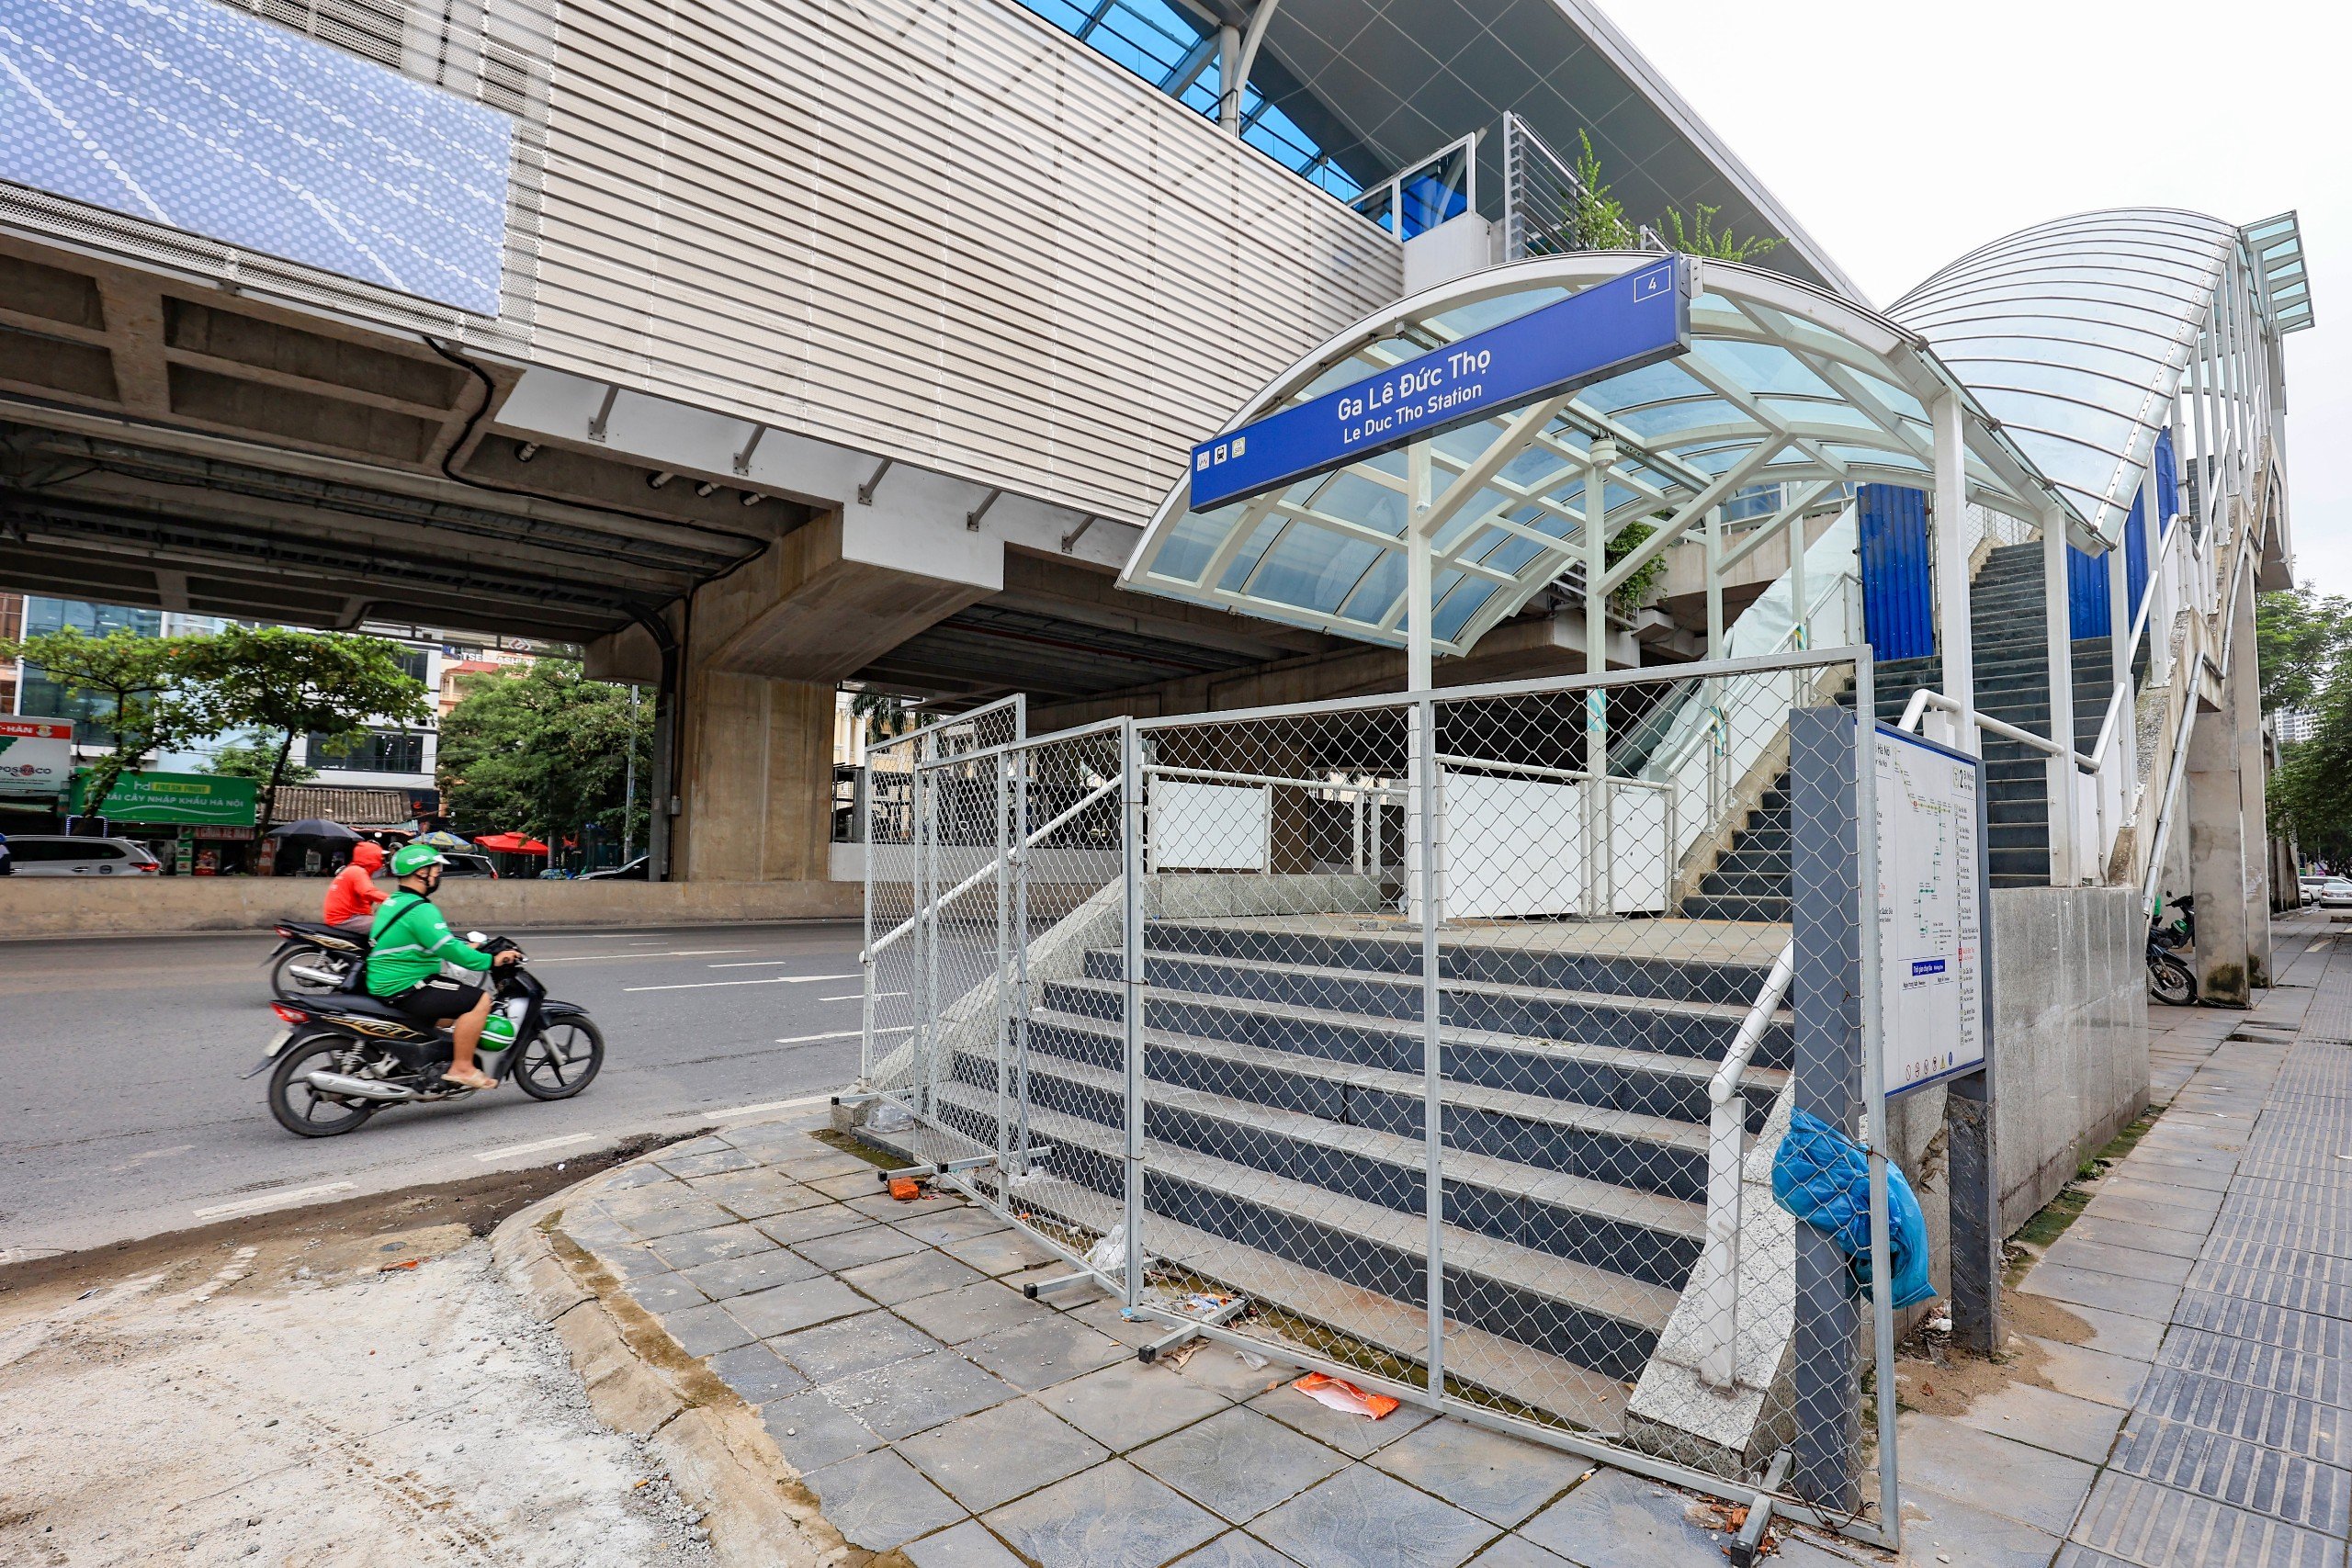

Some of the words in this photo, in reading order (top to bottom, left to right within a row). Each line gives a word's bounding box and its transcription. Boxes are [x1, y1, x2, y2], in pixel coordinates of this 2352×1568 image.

[1648, 277, 1657, 290] 4
[1338, 399, 1363, 421] Ga
[1369, 381, 1395, 411] Lê
[1399, 367, 1442, 399] Đức
[1448, 350, 1491, 378] Thọ
[1343, 428, 1361, 445] Le
[1365, 417, 1393, 436] Duc
[1396, 405, 1423, 424] Tho
[1427, 384, 1482, 414] Station
